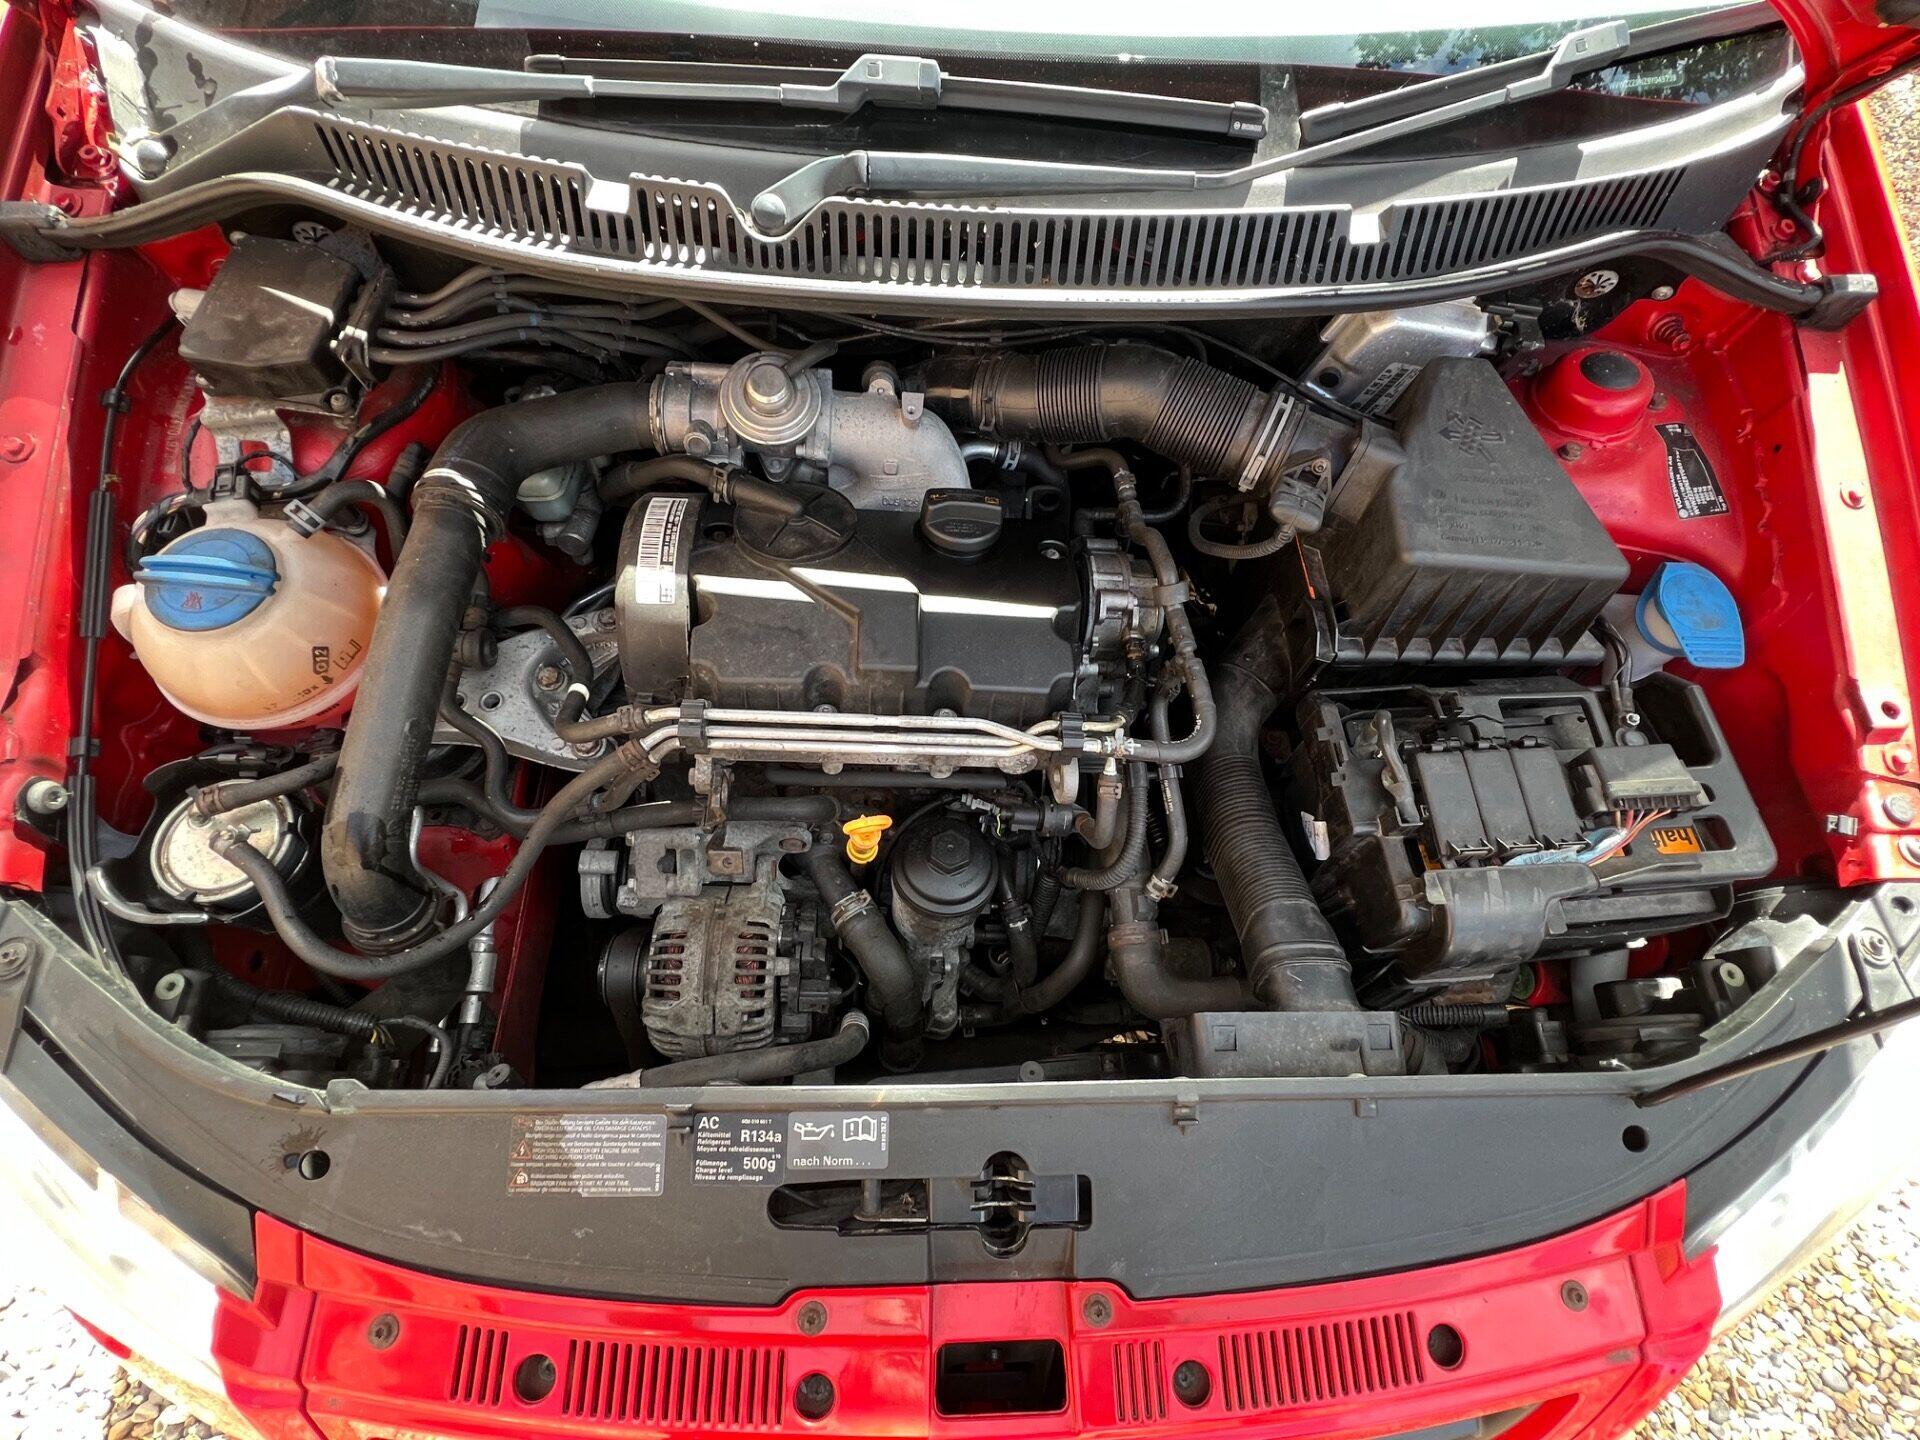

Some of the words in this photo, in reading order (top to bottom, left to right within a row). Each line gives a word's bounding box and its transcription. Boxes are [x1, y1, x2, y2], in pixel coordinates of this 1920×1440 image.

[698, 1116, 720, 1129] AC
[741, 1129, 782, 1143] R134a
[743, 1157, 776, 1172] 500g
[793, 1156, 820, 1166] nach
[823, 1157, 853, 1166] Norm
